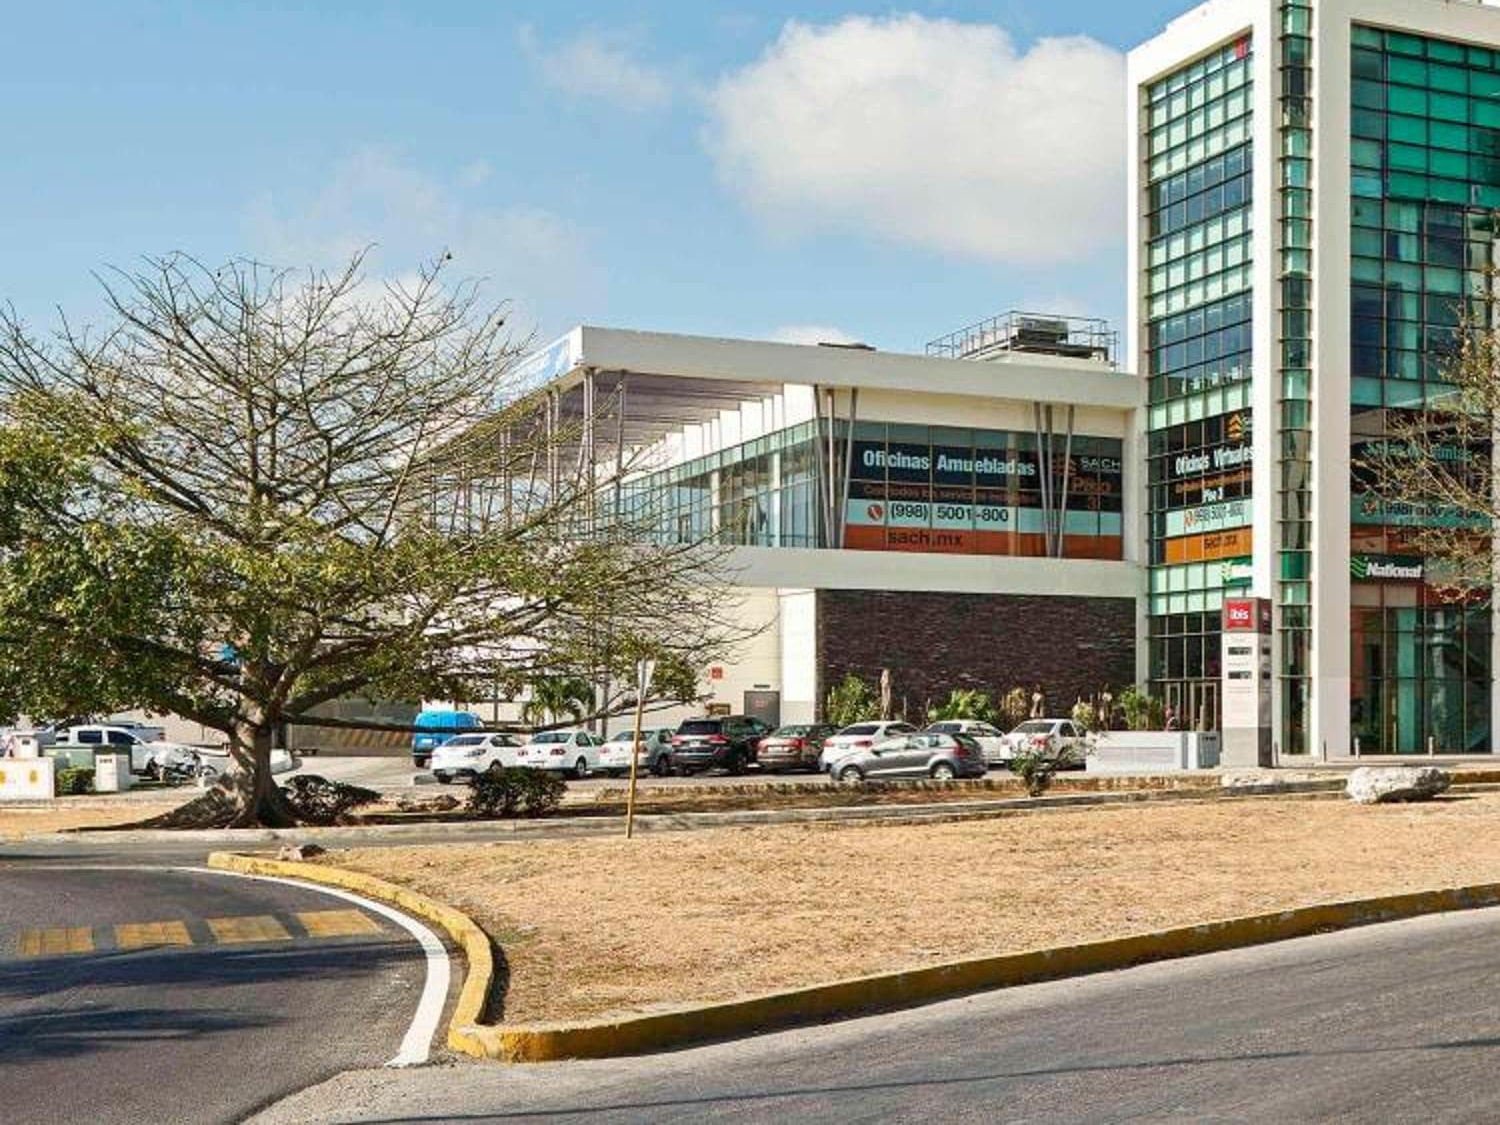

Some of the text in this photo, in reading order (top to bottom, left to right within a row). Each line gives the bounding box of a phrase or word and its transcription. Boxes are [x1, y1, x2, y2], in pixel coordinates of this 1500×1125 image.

[863, 449, 1036, 476] Oficinas Amuebladas
[890, 501, 929, 522] (998)
[887, 530, 964, 547] sach.mx
[1366, 561, 1423, 578] National
